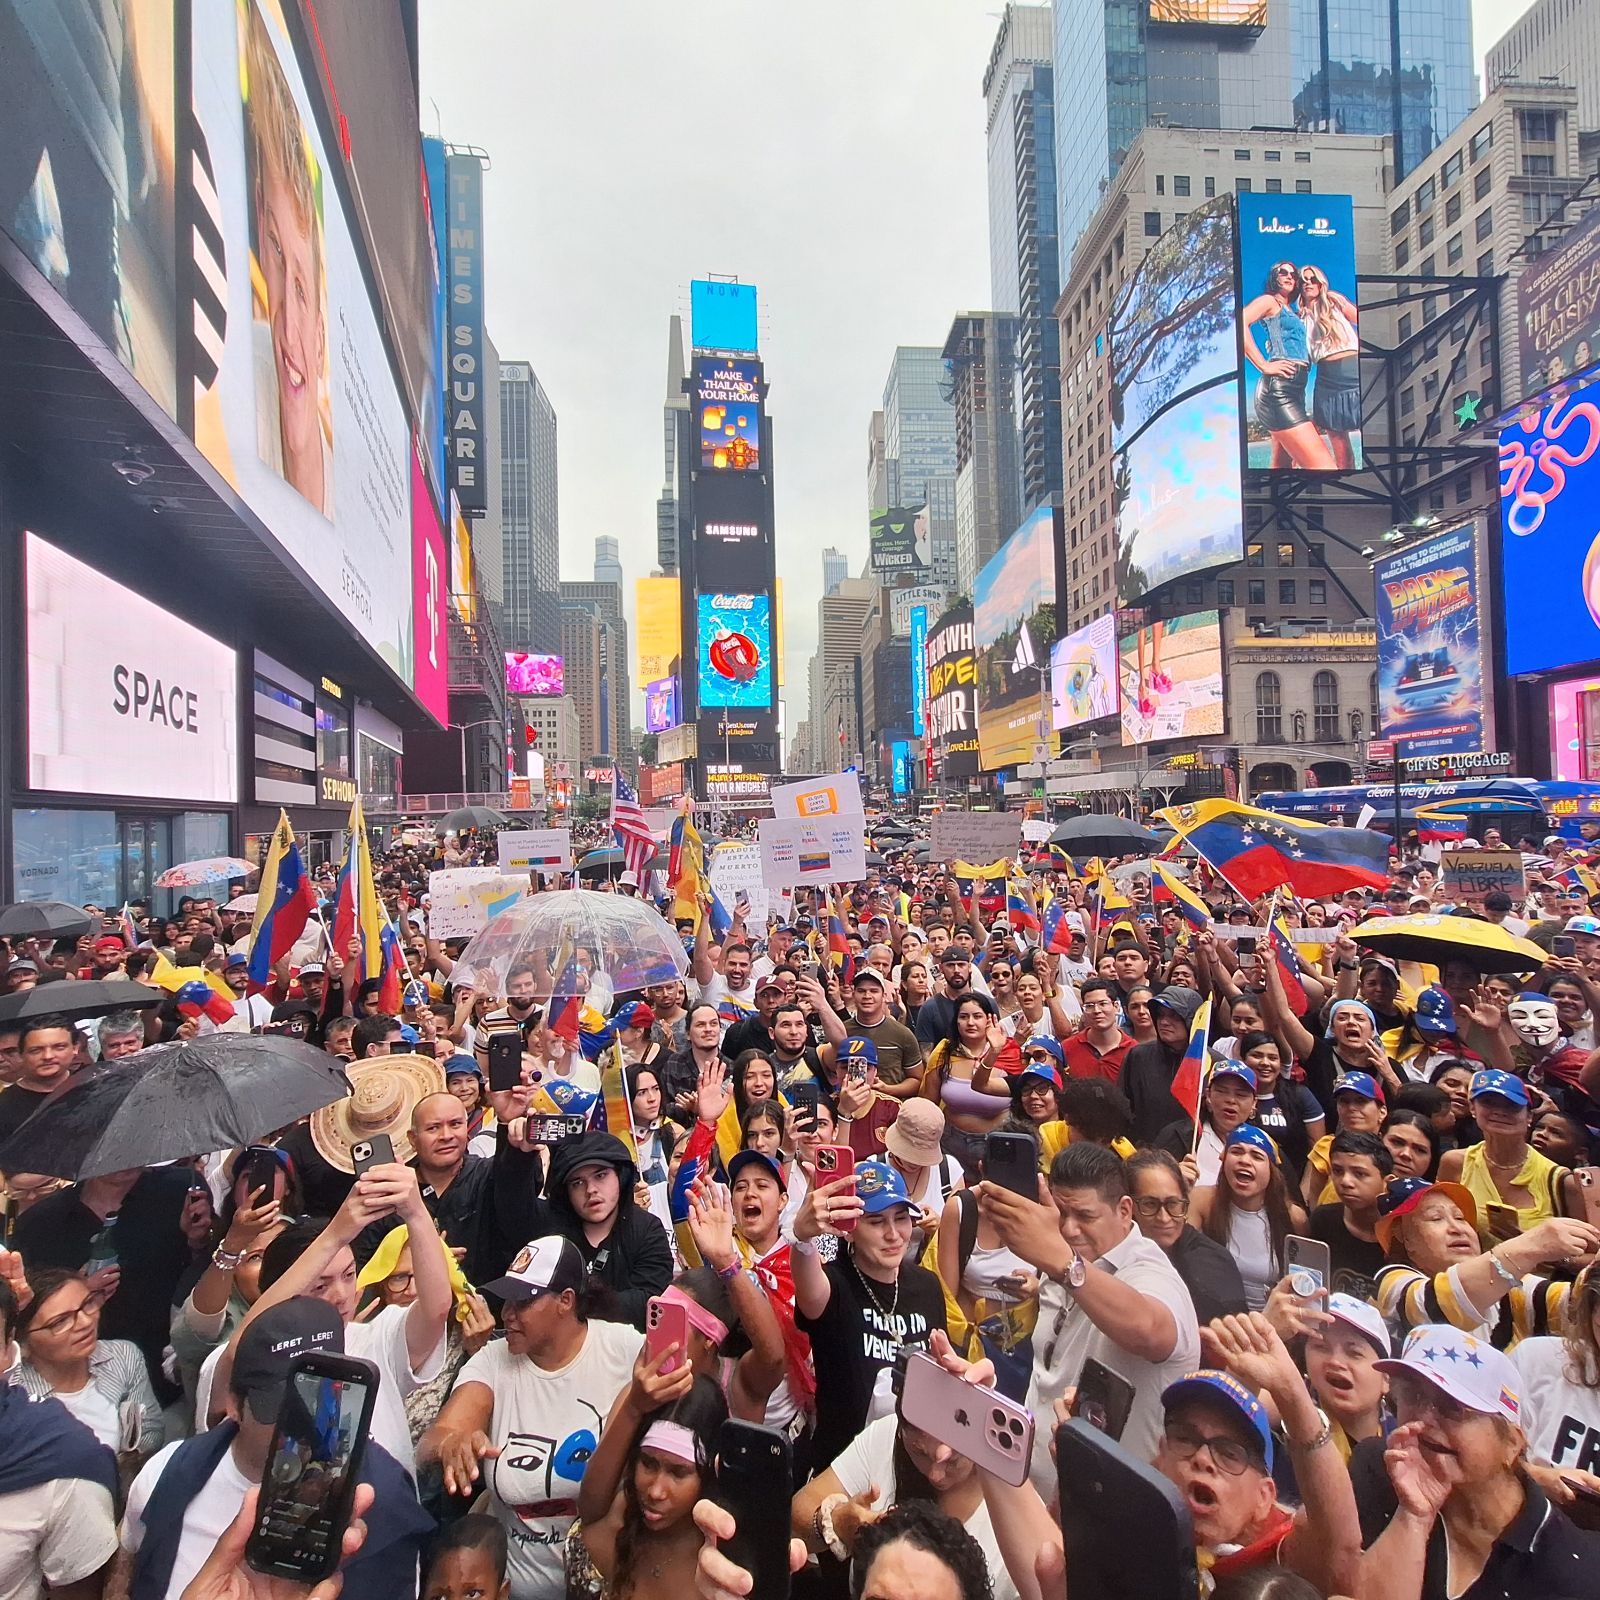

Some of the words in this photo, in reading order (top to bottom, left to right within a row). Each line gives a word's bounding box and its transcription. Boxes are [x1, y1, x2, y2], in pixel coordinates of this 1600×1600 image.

[1258, 216, 1296, 233] Lulus
[451, 174, 475, 304] TIMES
[1541, 242, 1593, 290] EXTRAVAGANZA
[1554, 254, 1567, 270] BIG
[706, 284, 740, 297] NOW
[1526, 298, 1552, 338] THE
[1551, 336, 1565, 351] NEW
[1565, 319, 1591, 343] MUSICAL
[703, 379, 754, 392] THAILAND
[714, 370, 743, 381] MAKE
[453, 325, 476, 487] SQUARE
[698, 388, 728, 401] YOUR
[728, 392, 760, 403] HOME
[705, 524, 758, 537] SAMSUNG
[1381, 565, 1409, 580] MUSICAL
[1409, 553, 1439, 570] THEATER
[1440, 540, 1471, 558] HISTORY
[1403, 552, 1418, 563] TIME
[1418, 548, 1428, 557] TO
[1429, 536, 1459, 554] CHANGE
[341, 567, 373, 625] SEPHORA
[896, 589, 921, 604] LITTLE
[922, 589, 941, 601] SHOP
[1382, 566, 1469, 608] BACK
[1408, 581, 1473, 622] FUTURE
[1427, 613, 1440, 625] THE
[1440, 599, 1470, 618] MUSICAL
[946, 622, 976, 653] WH
[1329, 633, 1376, 644] MILLER
[322, 676, 342, 699] SEPHORA
[113, 664, 198, 735] SPACE
[729, 765, 743, 774] WHO
[1406, 759, 1440, 772] GIFTS
[1448, 752, 1510, 769] LUGGAGE
[323, 777, 356, 802] SEPHORA
[706, 782, 715, 794] IS
[1434, 783, 1458, 796] bus
[20, 866, 59, 878] VORNADO
[719, 862, 759, 871] MUERTO
[1445, 856, 1515, 874] VENEZUELA
[1458, 876, 1512, 893] LIBRE
[547, 1119, 559, 1141] CALM
[558, 1122, 566, 1138] KEEP
[910, 1312, 927, 1334] IN
[271, 1336, 303, 1353] LERET
[311, 1330, 334, 1342] LERET
